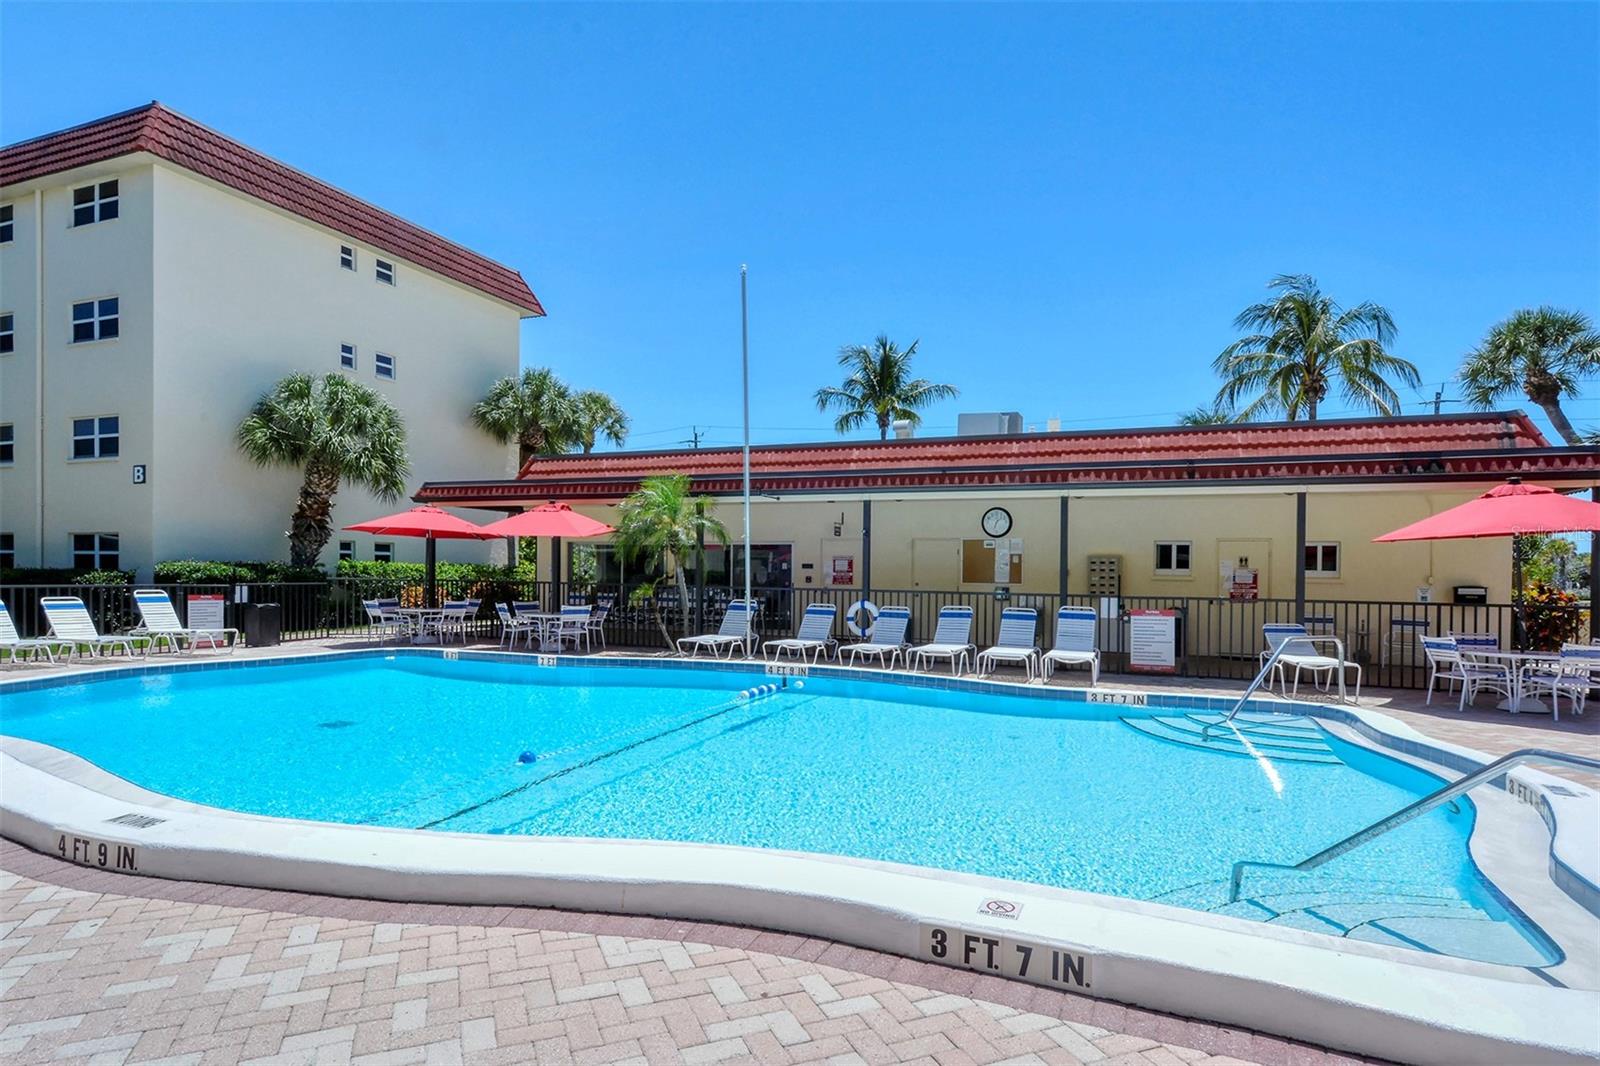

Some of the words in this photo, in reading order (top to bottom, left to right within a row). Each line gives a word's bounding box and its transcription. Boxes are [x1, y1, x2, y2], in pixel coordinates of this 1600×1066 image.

[134, 466, 144, 482] B
[768, 666, 773, 675] 4
[777, 666, 786, 675] FT
[789, 667, 795, 676] 9
[798, 667, 806, 676] IN
[1091, 693, 1097, 702] 3
[1103, 694, 1115, 703] FT
[1121, 695, 1127, 704] 7
[1133, 695, 1144, 705] IN
[1508, 779, 1515, 794] 3
[58, 834, 66, 857] 4
[73, 837, 90, 863] FT.
[98, 843, 107, 867] 9
[116, 845, 138, 871] IN.
[991, 911, 1016, 919] DIVING
[931, 928, 947, 958] 3
[963, 934, 999, 970] FT.
[1016, 944, 1033, 977] 7
[1051, 950, 1091, 988] IN.
